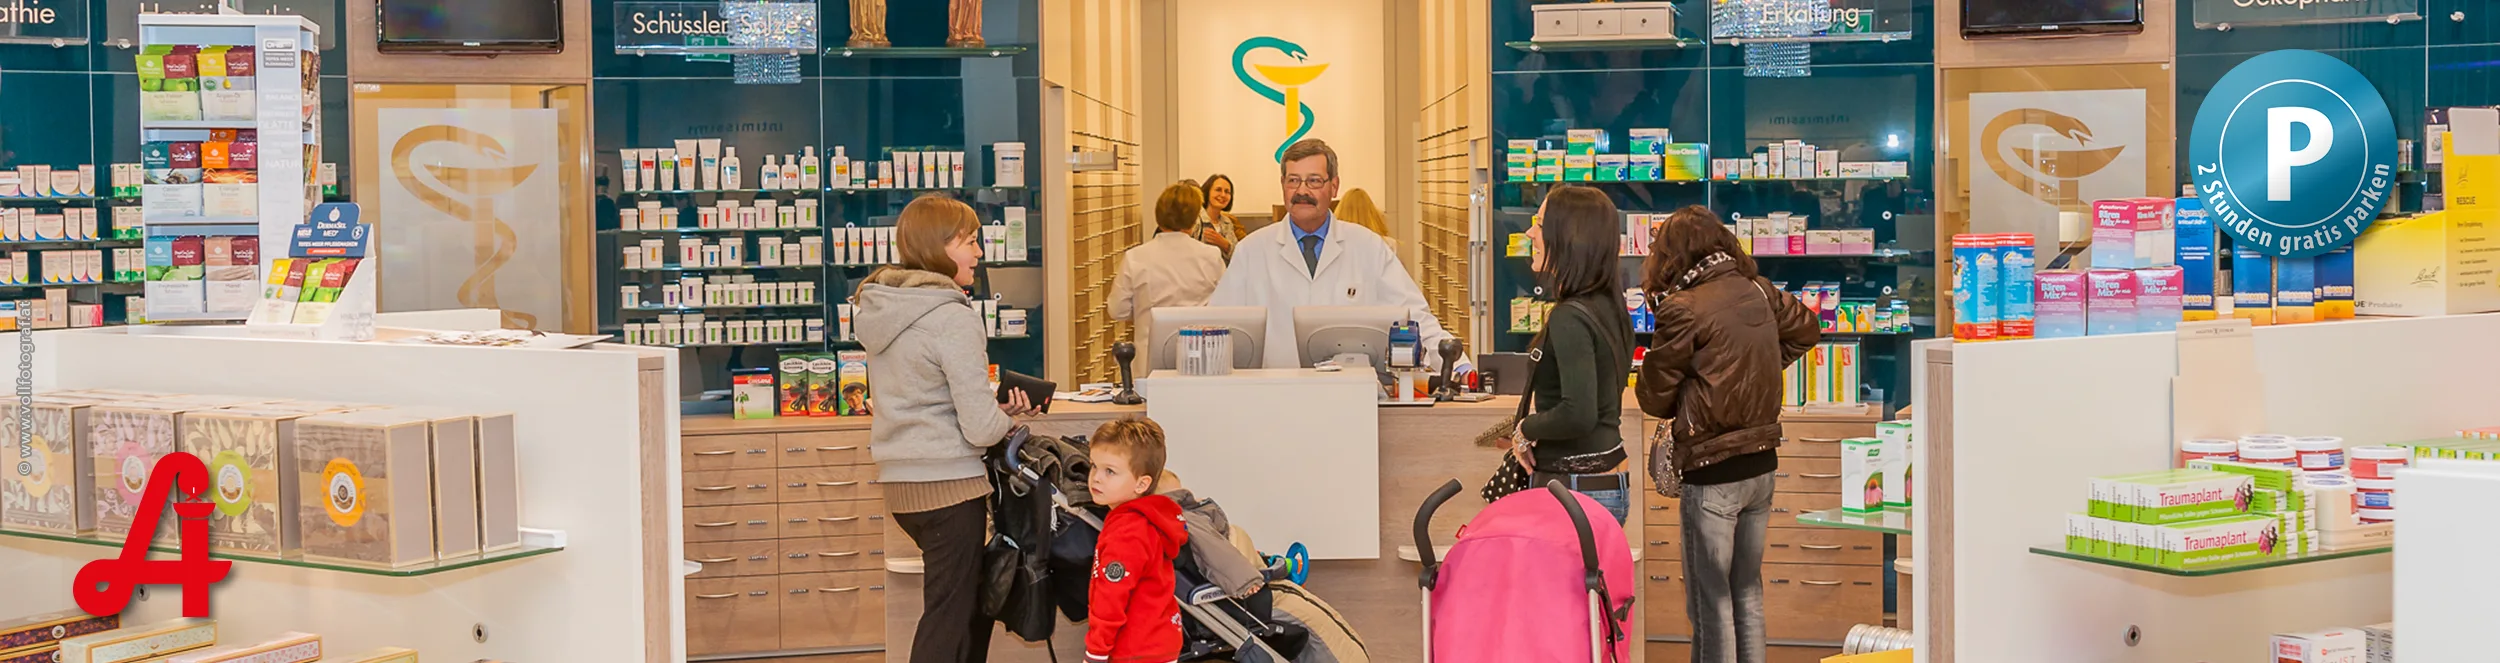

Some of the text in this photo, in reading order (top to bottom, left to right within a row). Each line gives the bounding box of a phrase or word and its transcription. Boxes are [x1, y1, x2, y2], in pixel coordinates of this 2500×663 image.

[633, 10, 799, 35] Schüssler Salze
[1762, 0, 1859, 27] Erkaltung
[2159, 487, 2223, 507] Traumaplant
[2184, 530, 2248, 551] Traumaplant
